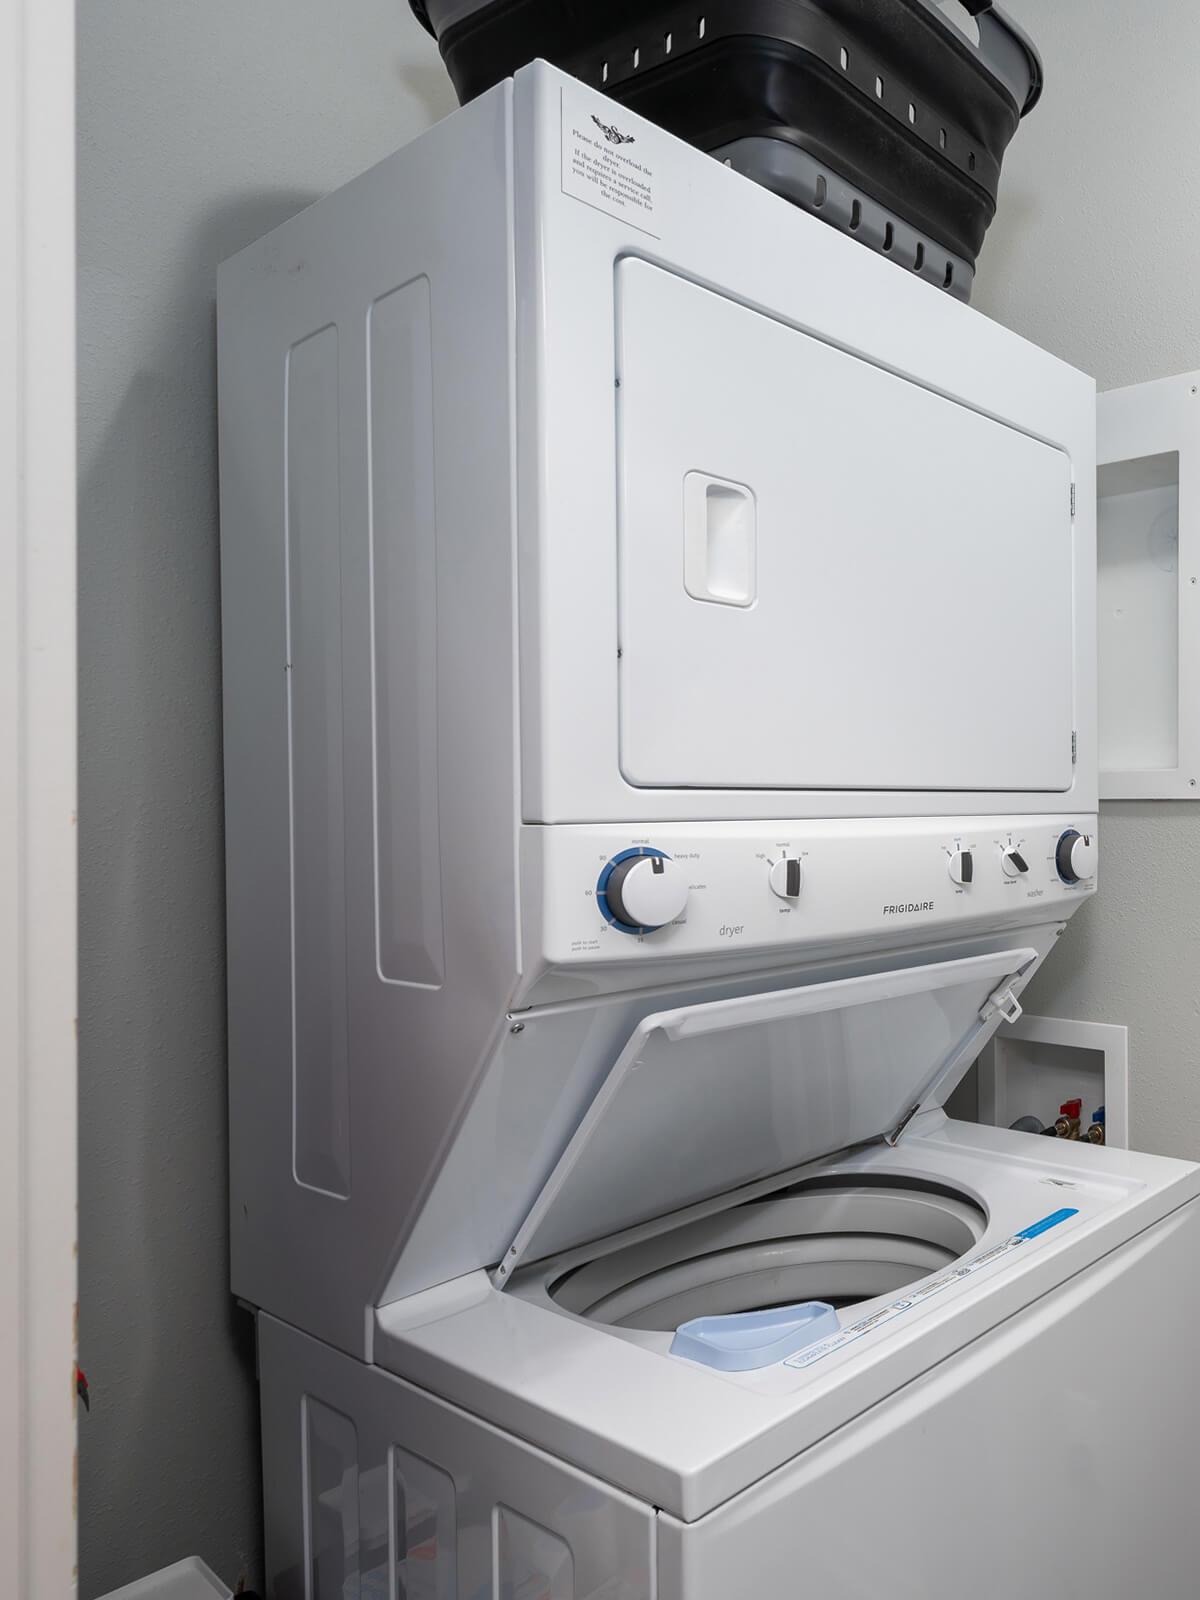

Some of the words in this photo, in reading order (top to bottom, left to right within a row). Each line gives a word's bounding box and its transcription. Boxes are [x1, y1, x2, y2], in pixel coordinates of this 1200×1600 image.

[572, 129, 592, 143] Please
[594, 141, 603, 150] do
[604, 147, 614, 156] not
[615, 154, 642, 171] overload
[643, 167, 652, 176] the
[574, 148, 580, 156] If
[581, 152, 591, 161] the
[593, 159, 610, 171] dryer
[611, 168, 617, 176] is
[572, 158, 585, 168] and
[586, 165, 612, 182] requires
[618, 181, 639, 196] service
[572, 167, 585, 177] you
[586, 174, 599, 185] will
[599, 179, 608, 189] be
[609, 184, 643, 207] responsible
[644, 202, 653, 211] for
[600, 189, 611, 200] the
[882, 901, 935, 915] FRIGIDAIRE
[719, 924, 744, 937] dryer
